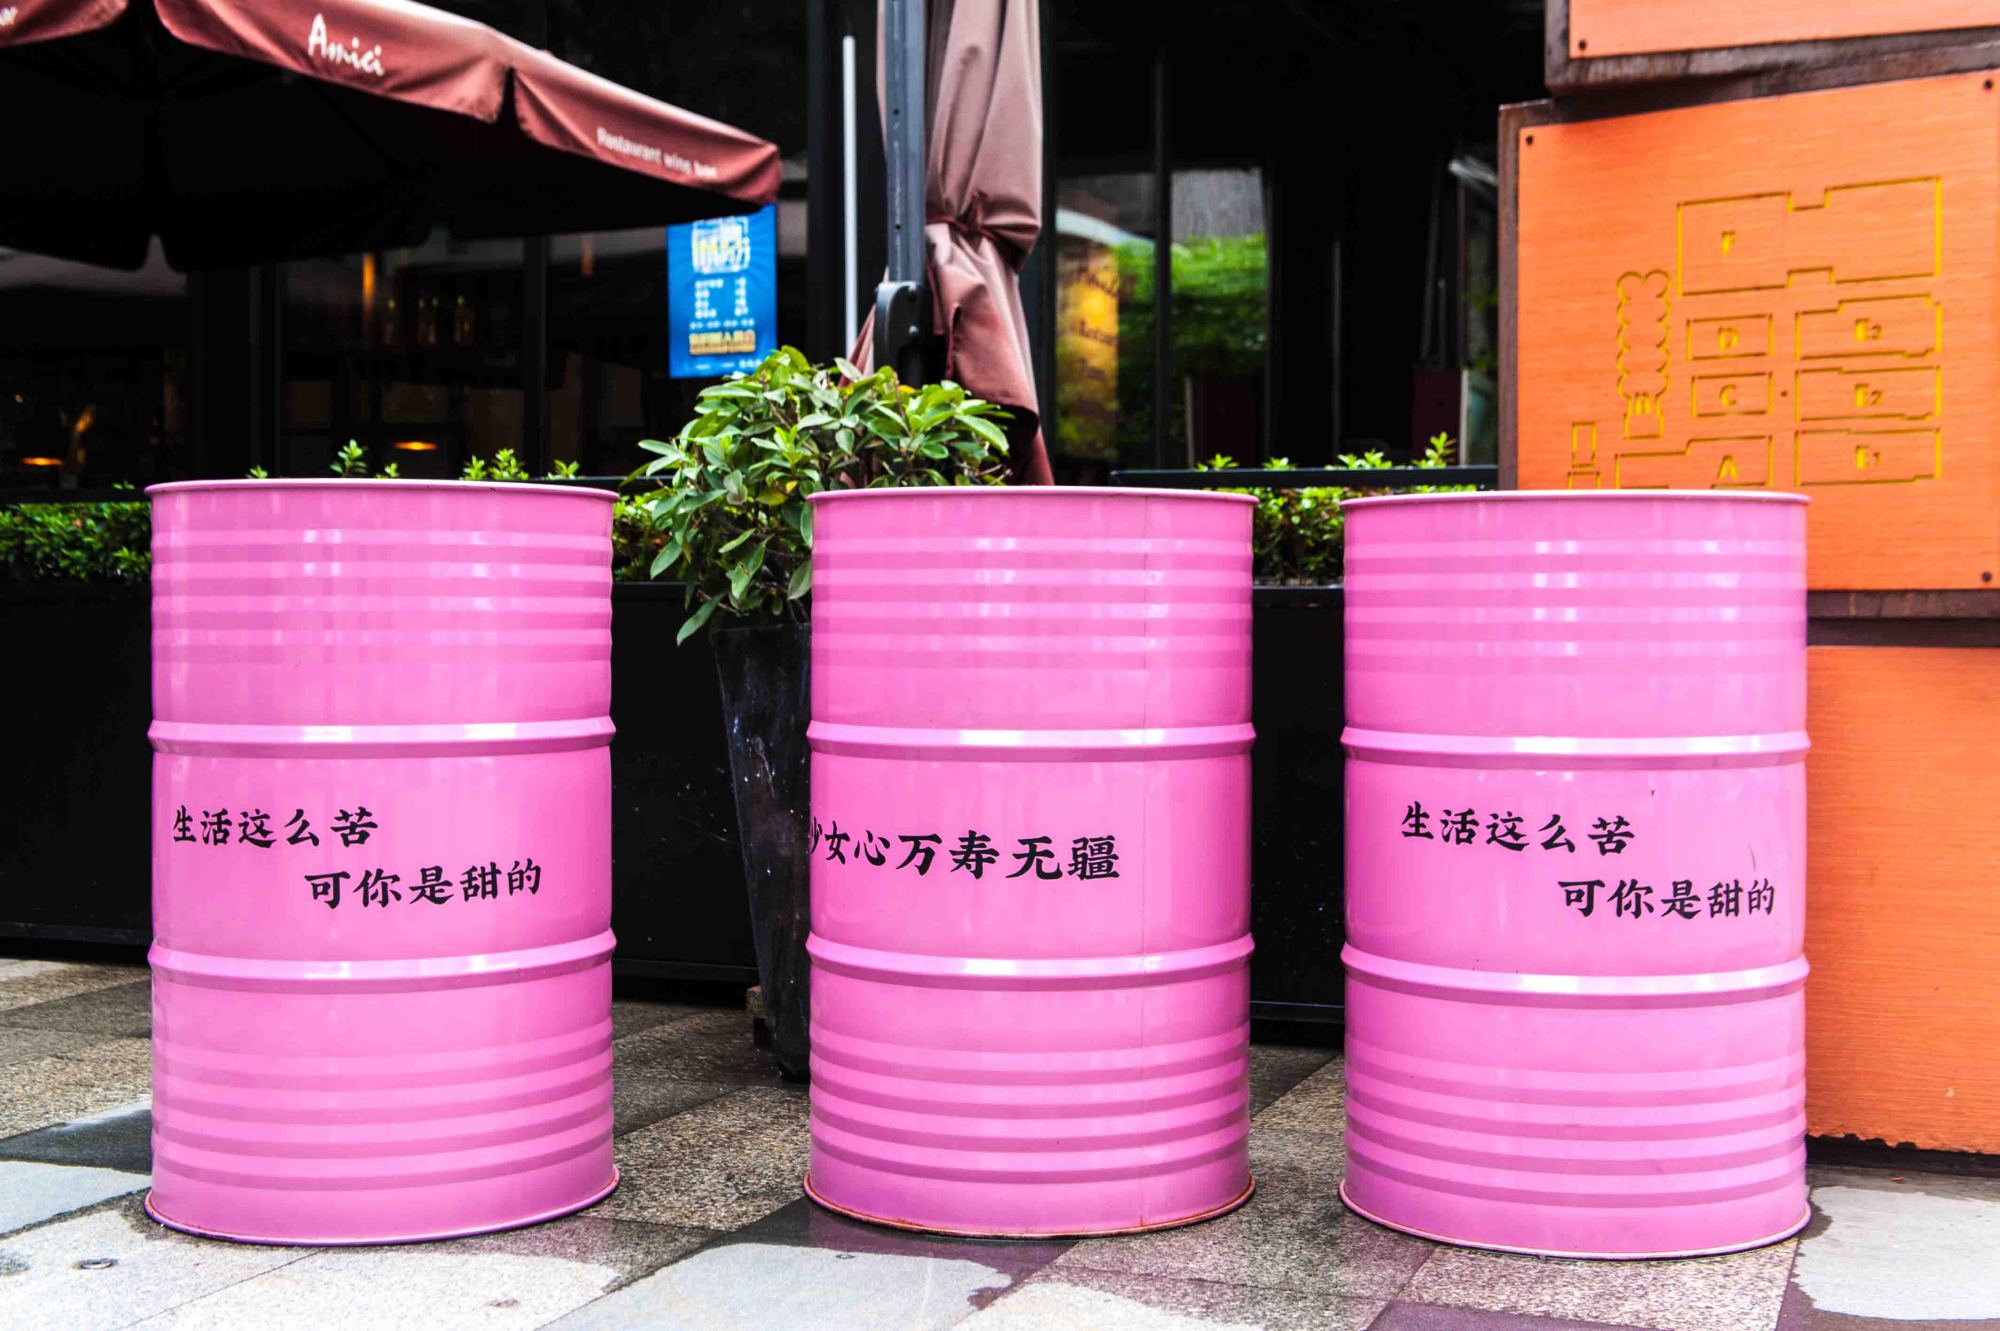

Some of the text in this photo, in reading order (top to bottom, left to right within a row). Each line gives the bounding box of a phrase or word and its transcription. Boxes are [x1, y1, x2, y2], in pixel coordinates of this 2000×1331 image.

[307, 12, 385, 77] Amici
[1721, 230, 1737, 255] F
[1718, 326, 1739, 349] D
[1719, 383, 1738, 408] C
[1854, 382, 1884, 408] E2
[1717, 454, 1740, 480] A
[1855, 444, 1883, 470] E1
[173, 804, 378, 849] 生活这么苦
[1401, 801, 1635, 856] 生活这么苦
[810, 816, 1120, 880] 少女心万寿无疆
[304, 858, 541, 909] 可你是甜的
[1557, 878, 1775, 920] 可你是甜的
